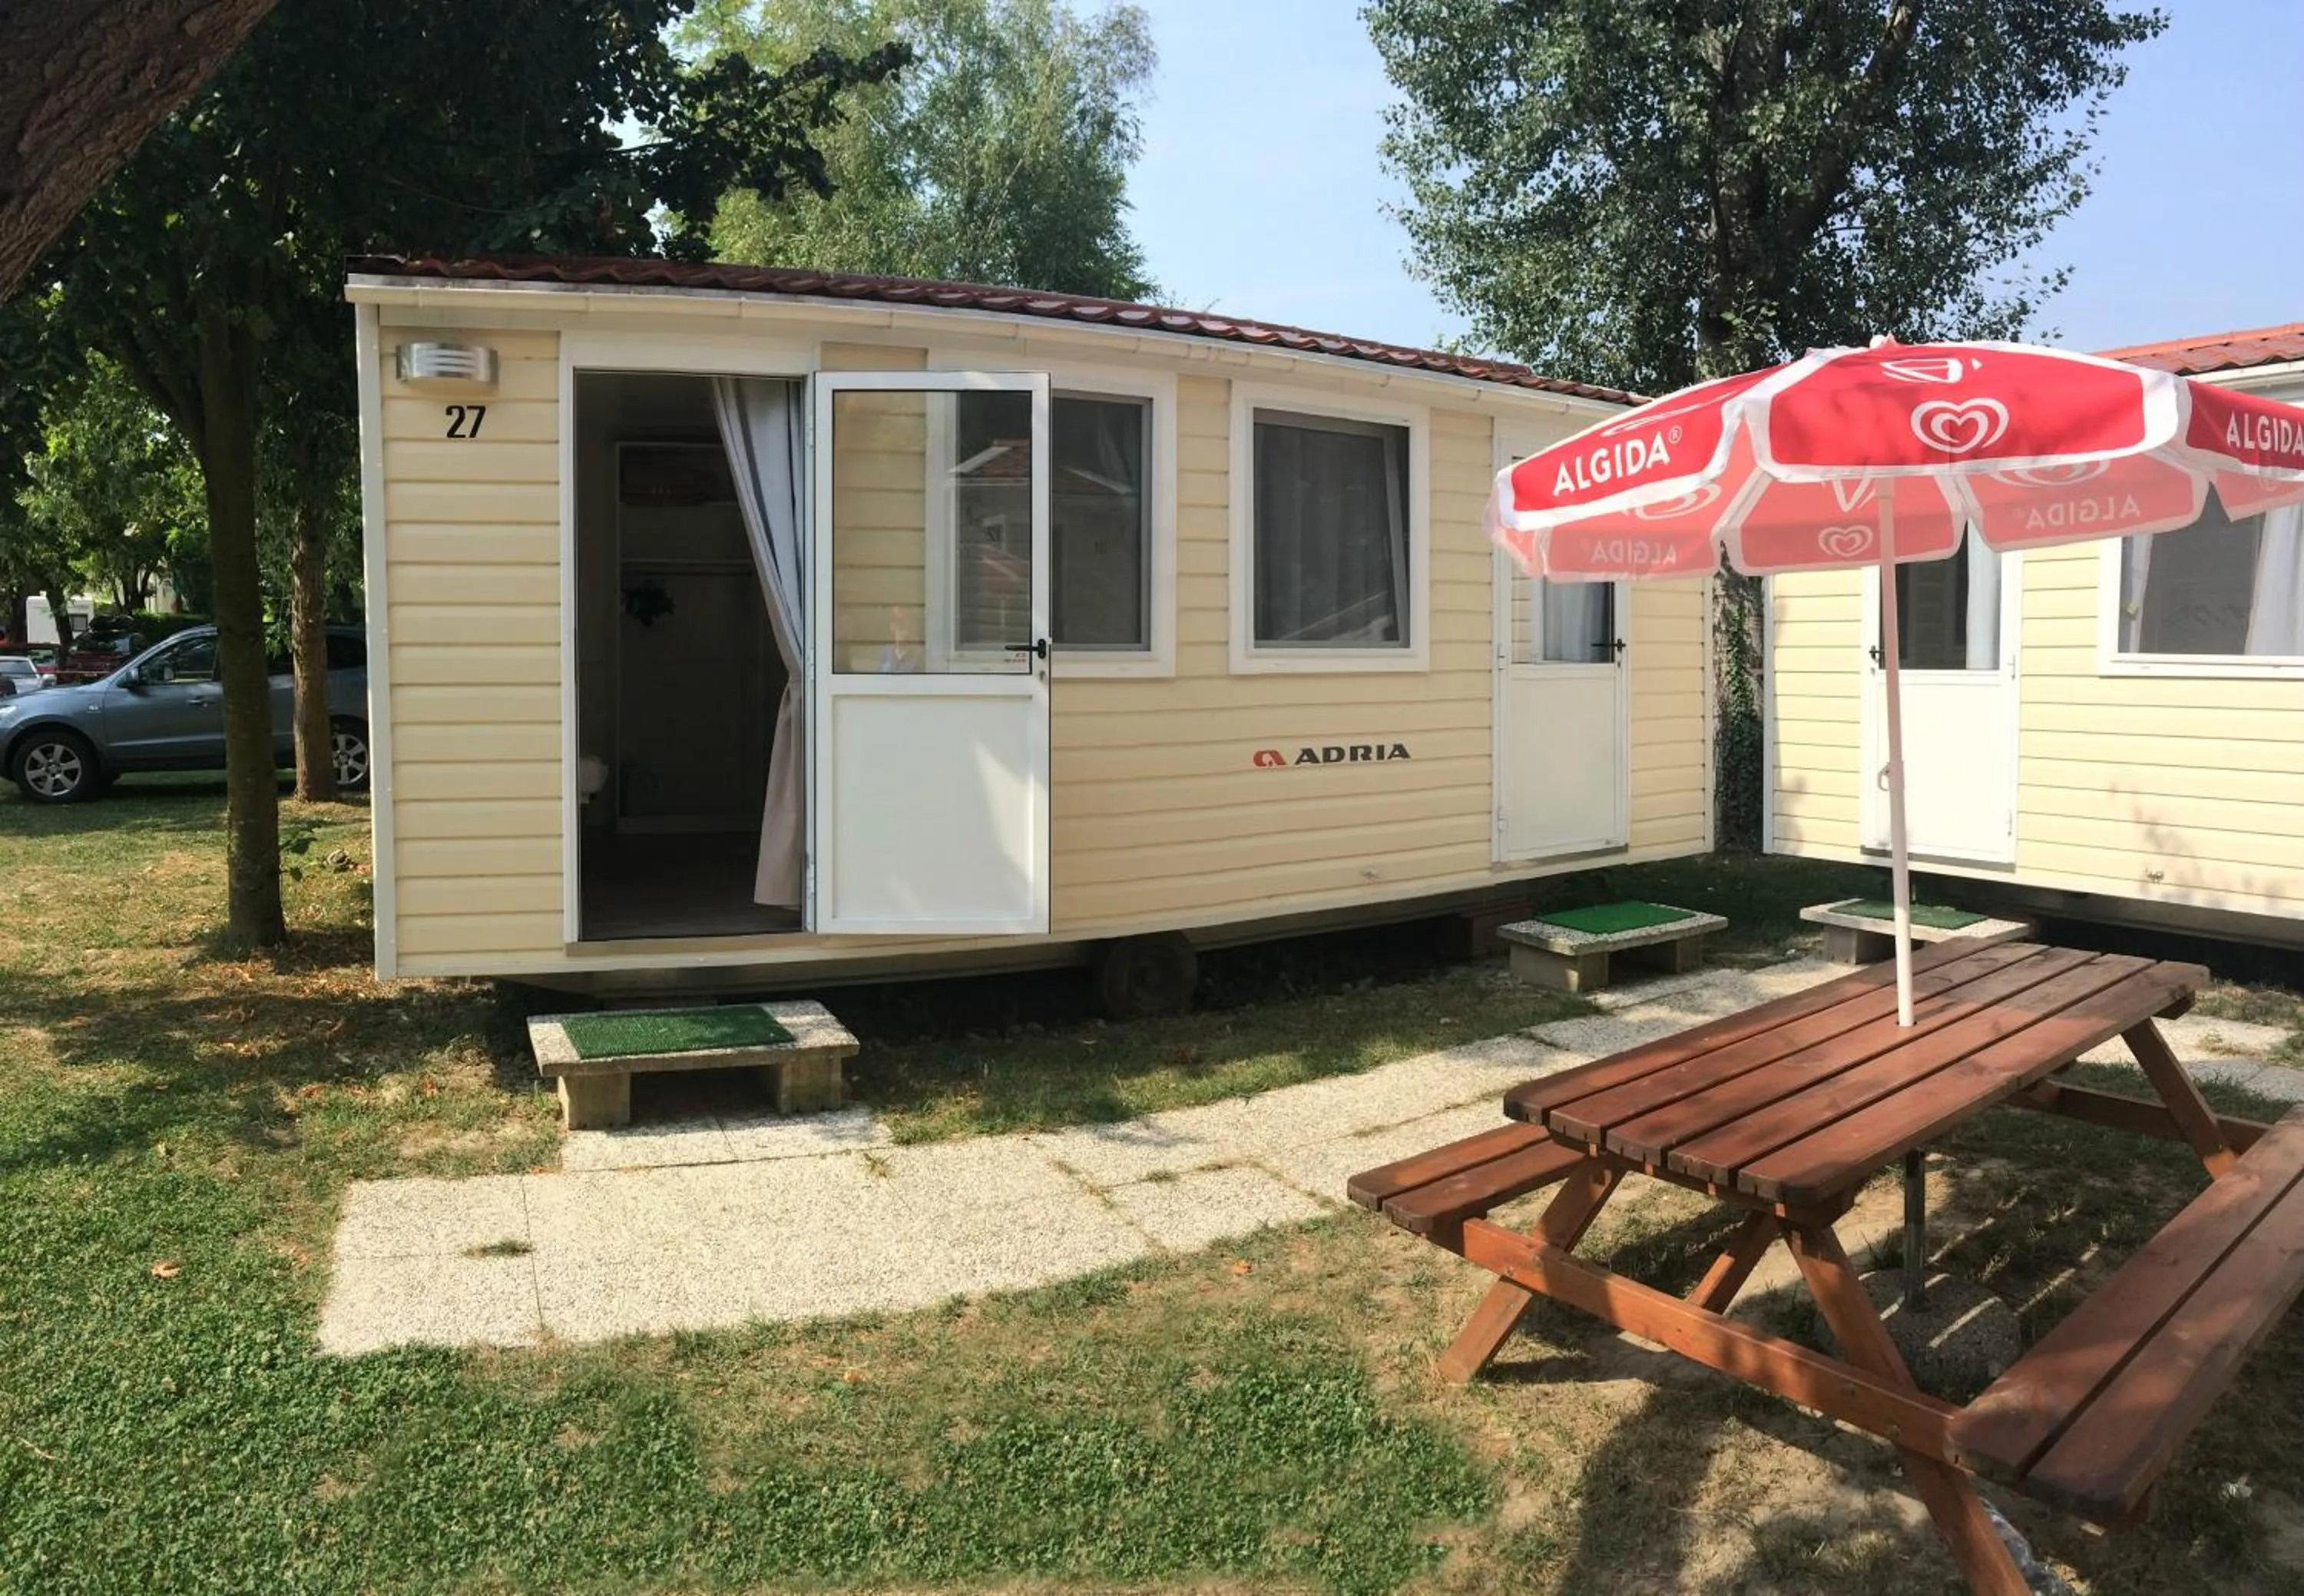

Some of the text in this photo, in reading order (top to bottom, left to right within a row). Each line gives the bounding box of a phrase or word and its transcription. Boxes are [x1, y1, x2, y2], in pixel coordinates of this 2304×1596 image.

[445, 404, 487, 439] 27
[2226, 410, 2304, 457] ALGIDA
[1294, 743, 1412, 766] ADRIA
